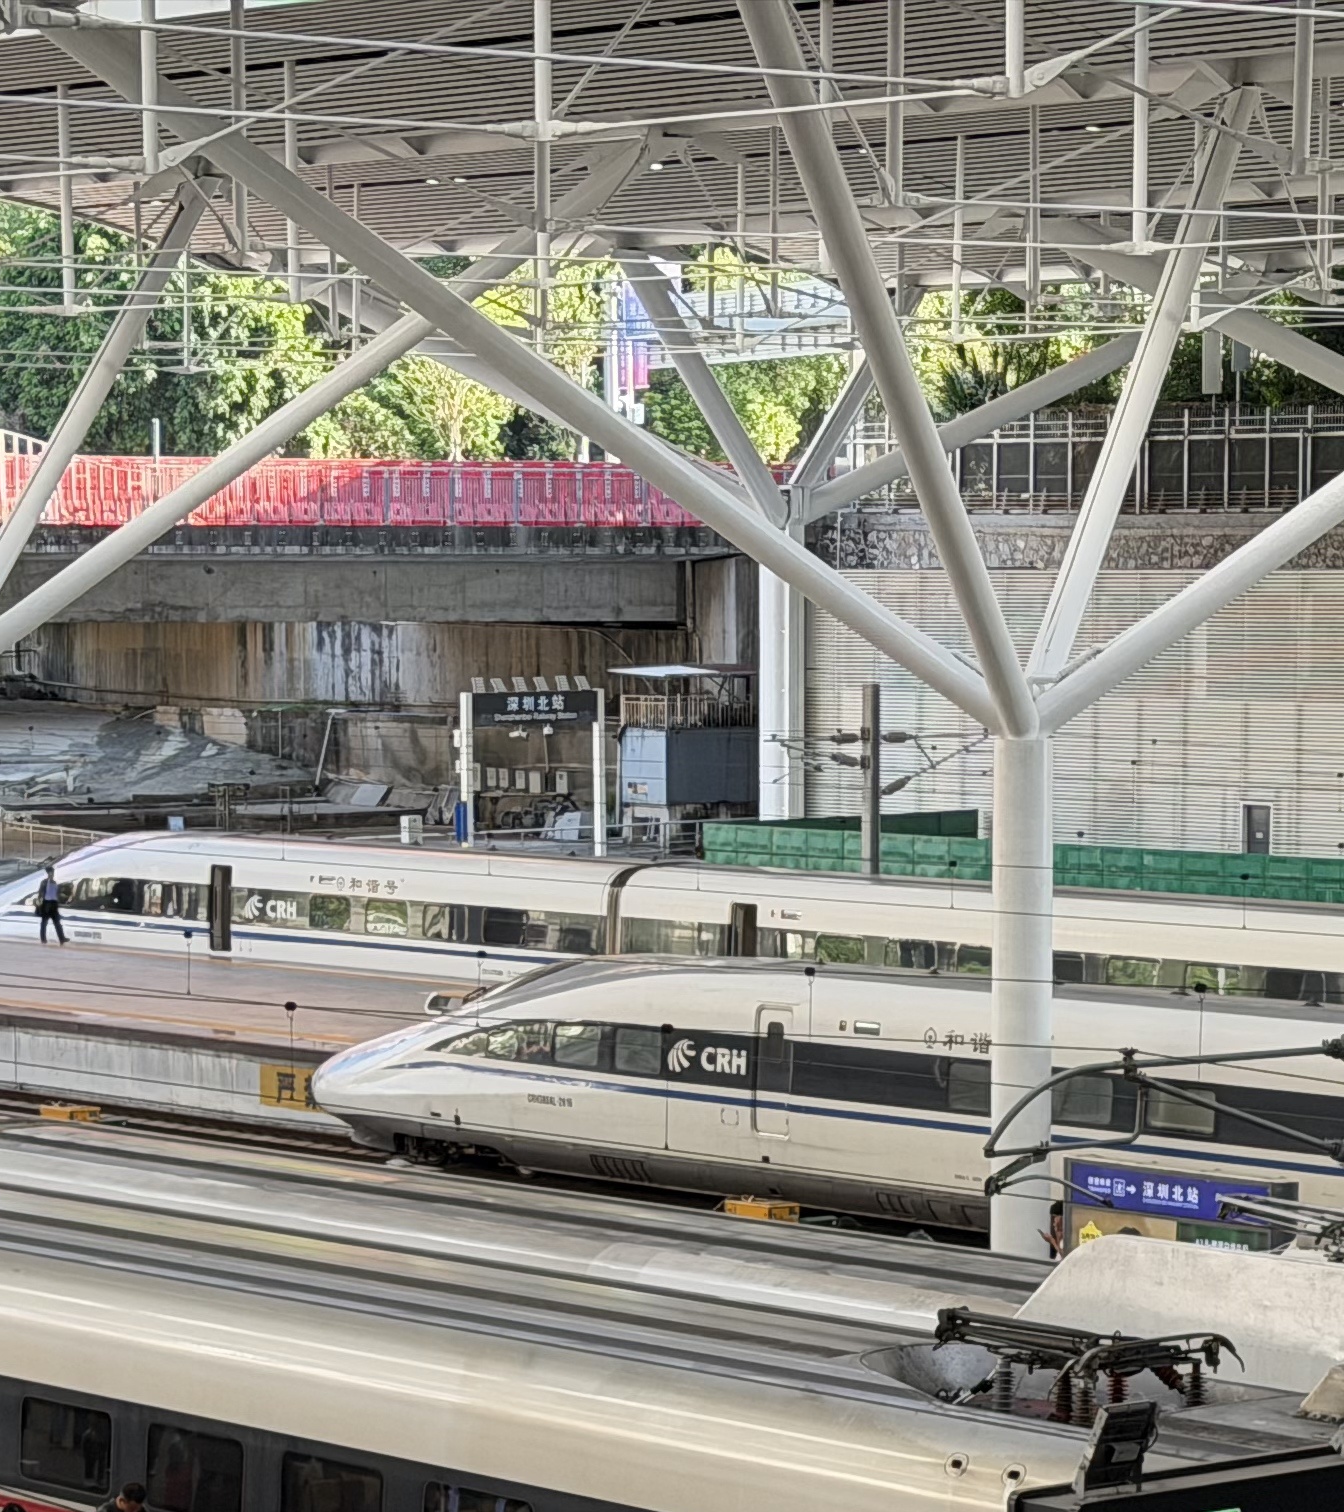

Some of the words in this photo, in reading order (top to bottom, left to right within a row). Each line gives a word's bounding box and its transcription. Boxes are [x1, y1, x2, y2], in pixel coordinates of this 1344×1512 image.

[349, 877, 398, 896] 和谐号
[266, 900, 297, 920] CRH
[700, 1047, 748, 1075] CRH
